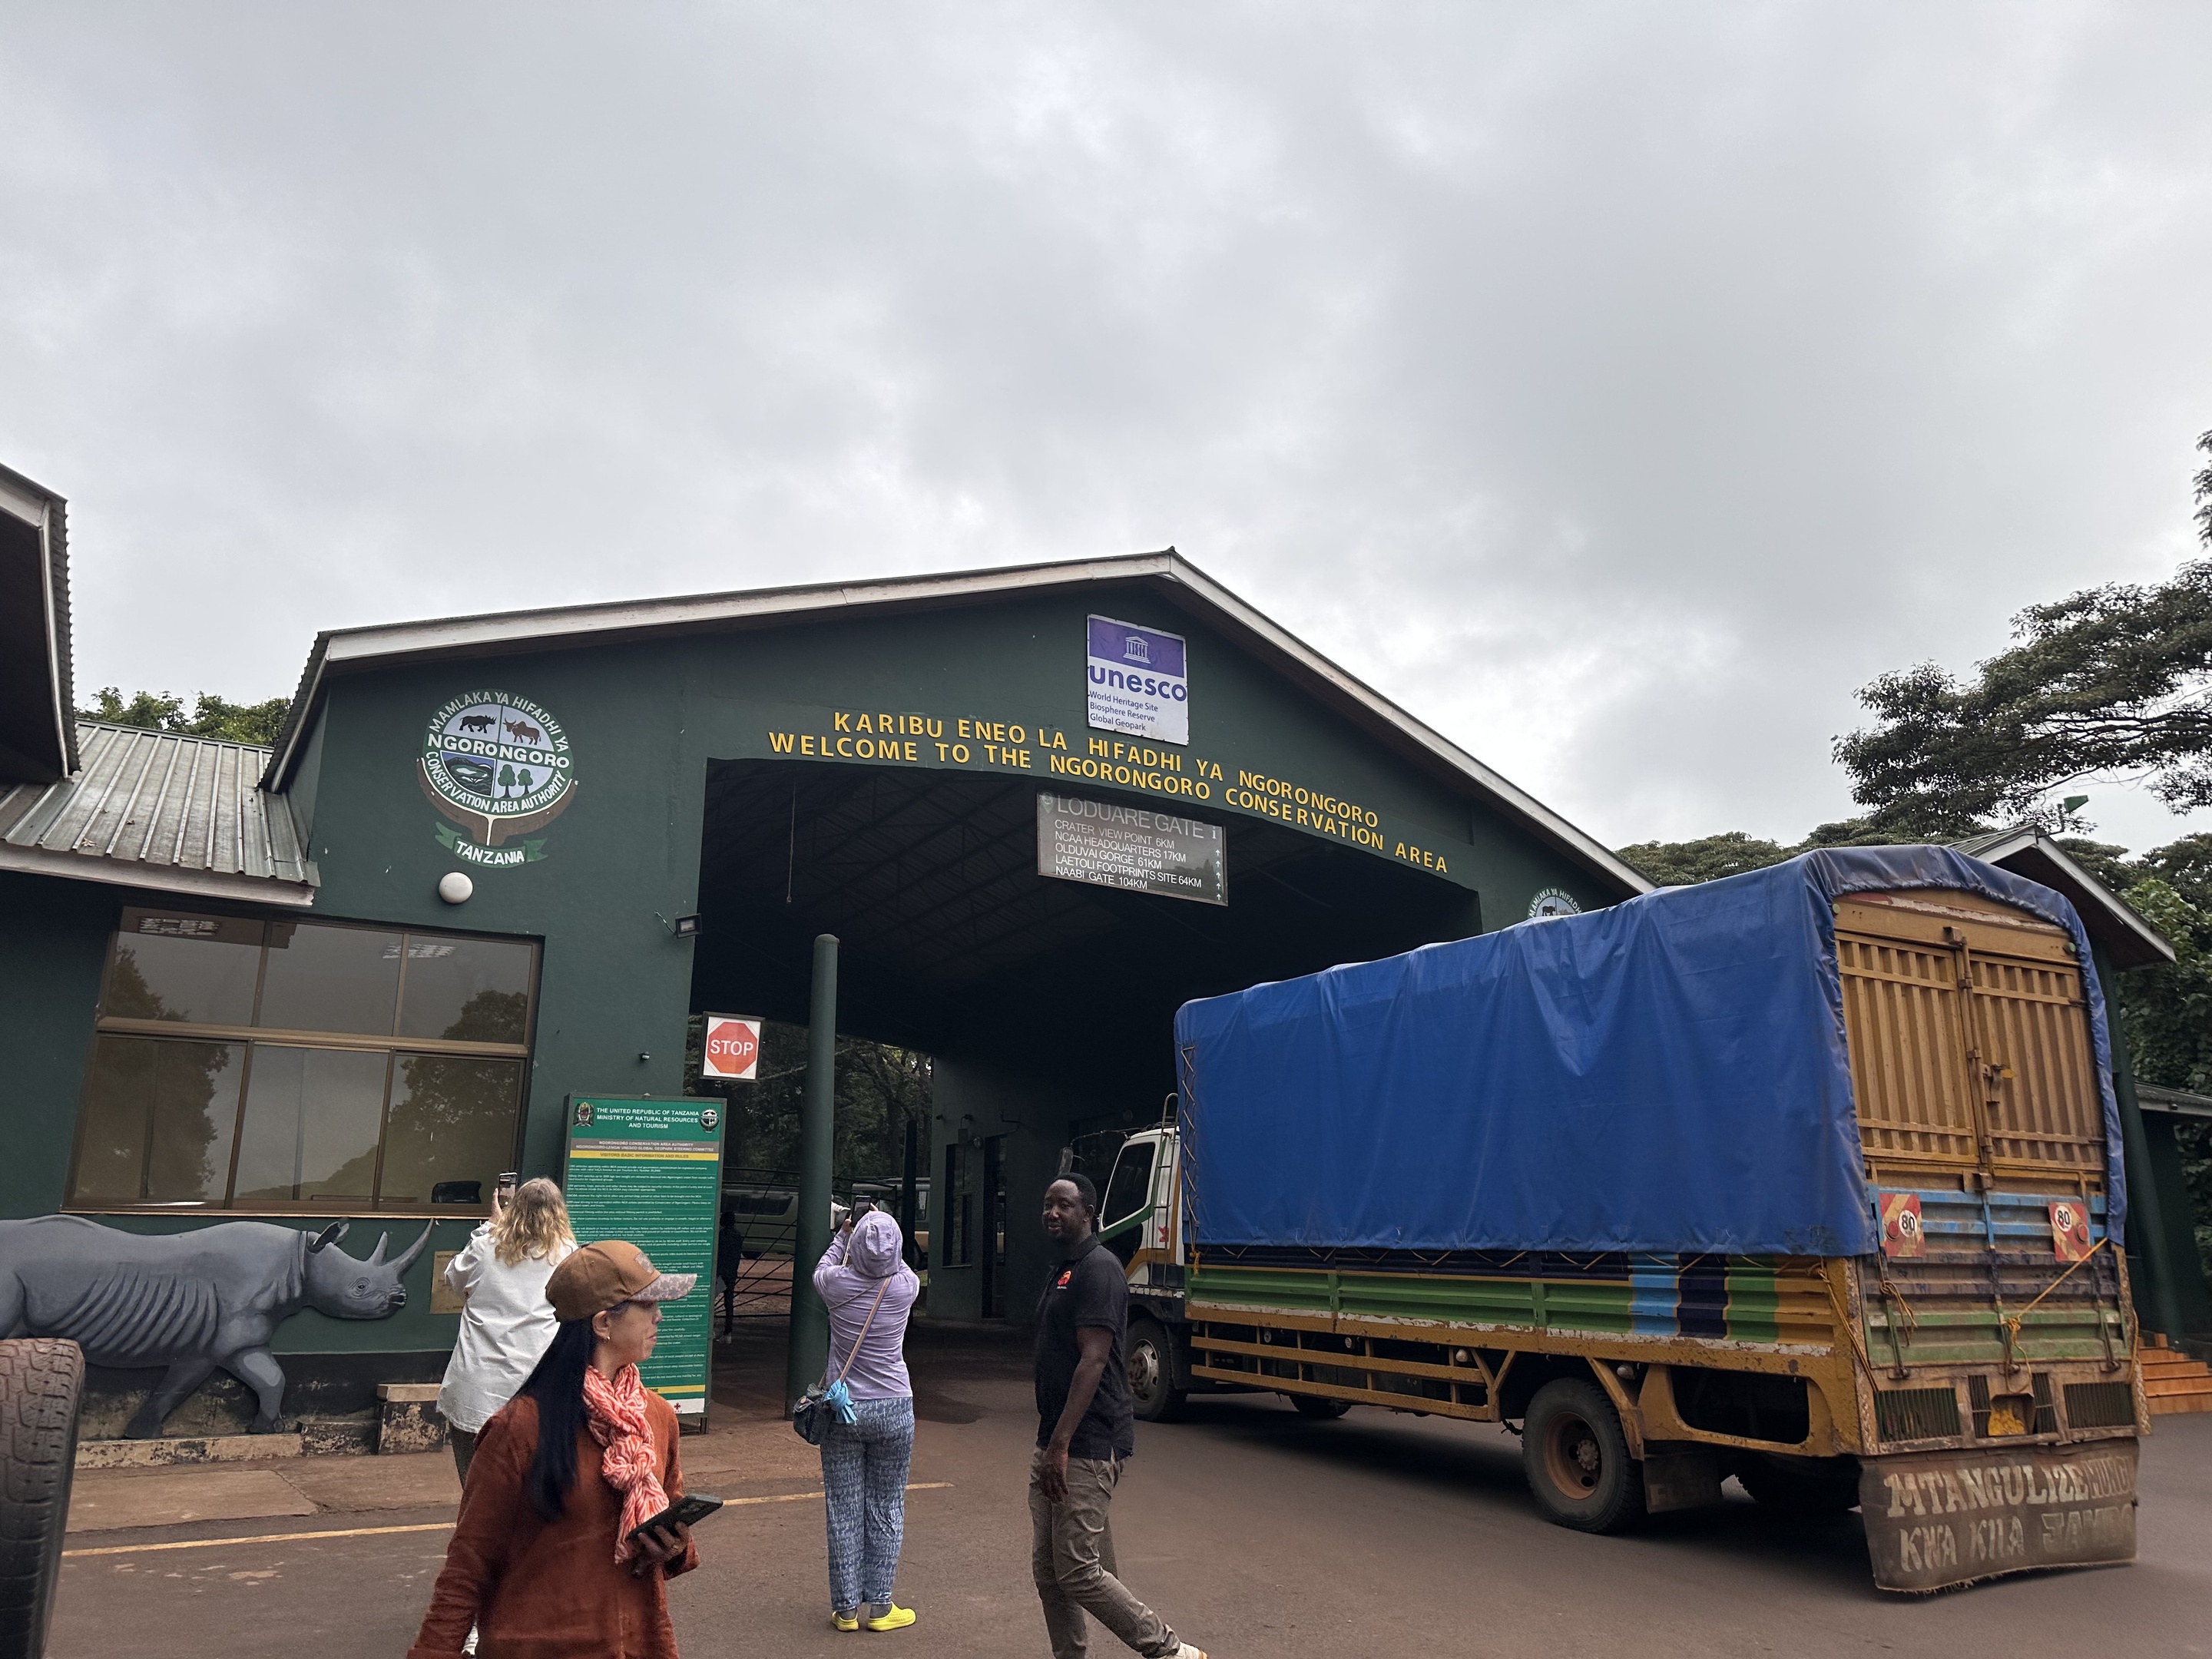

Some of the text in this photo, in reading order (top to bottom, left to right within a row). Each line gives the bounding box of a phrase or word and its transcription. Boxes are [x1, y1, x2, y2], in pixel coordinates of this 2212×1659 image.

[1089, 665, 1187, 701] unesco
[1089, 690, 1158, 712] World Heritage Site
[1090, 702, 1155, 722] Biosphere Reserve
[429, 691, 569, 753] MAMLAKA YA HIFADHI YA
[1090, 713, 1147, 731] Global Geopark
[427, 733, 570, 769] NGORONGORO
[426, 751, 567, 813] CONSERVATION AREA AUTHORITY
[834, 711, 1379, 828] KARIBU ENEO LA HIFADHI YA NGORONGORO
[768, 732, 1449, 874] WELCOME TO THE NGORONGORO CONSERVATION AREA
[1058, 794, 1151, 829] LODUARE
[1154, 813, 1204, 839] GATE
[1055, 819, 1175, 849] CRATER VIEW POINT 6KM
[1055, 830, 1186, 863] NCAA HEADQUARTERS 17KM
[456, 840, 525, 865] TANZANIA
[1055, 843, 1162, 870] OLDUVAI GORGE 61KM
[1055, 853, 1202, 888] LAETOLI FOOTPRINTS SITE 64KM
[1055, 866, 1147, 889] NAABI GATE 104KM
[1528, 888, 1582, 918] MAMLAKA YA HIFADH
[710, 1039, 753, 1056] STOP
[1901, 1214, 1915, 1230] 80
[2058, 1210, 2070, 1225] 80
[1884, 1464, 2089, 1518] MTANGULIZE
[1899, 1525, 1958, 1572] KWA
